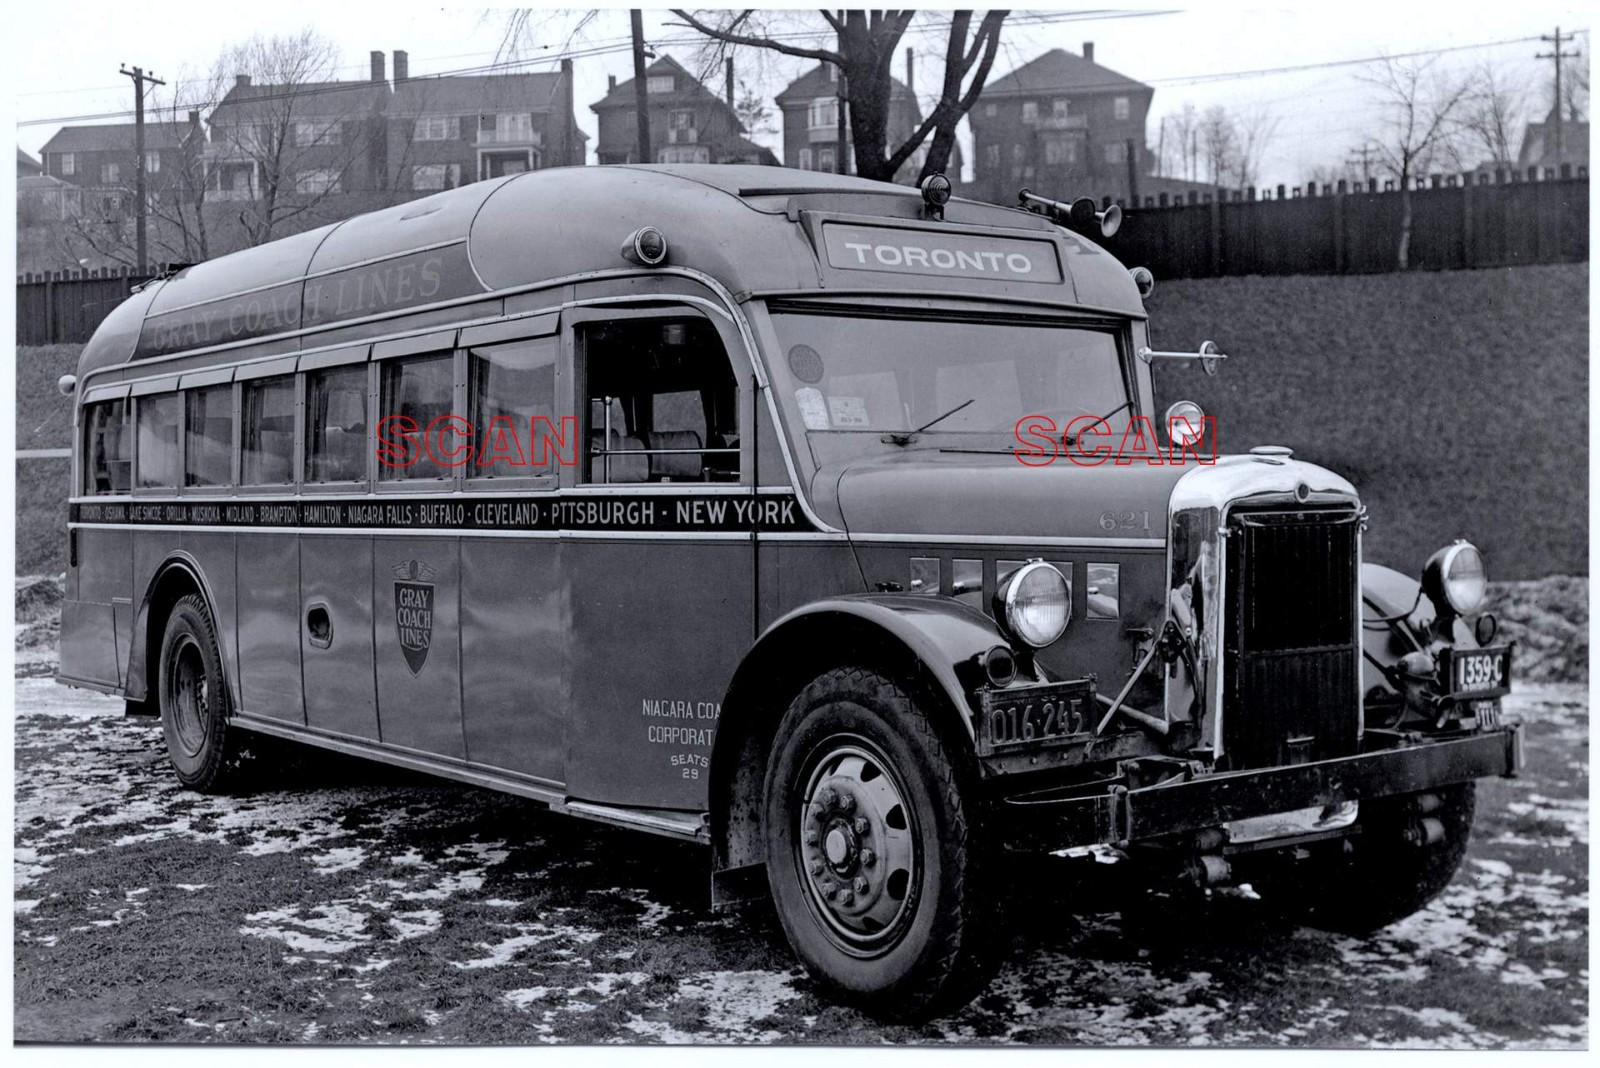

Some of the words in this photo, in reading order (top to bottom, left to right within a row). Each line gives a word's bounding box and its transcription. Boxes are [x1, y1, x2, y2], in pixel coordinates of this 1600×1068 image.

[845, 242, 1032, 273] TORONTO
[152, 309, 218, 350] GRAY
[228, 284, 322, 336] COACH
[335, 258, 443, 314] LINES
[192, 506, 221, 521] MUSKOKA
[226, 506, 254, 522] MIDLAND
[260, 506, 298, 523] BRAMPTON
[303, 505, 341, 524] HAMILTON
[348, 505, 384, 524] NIAGARA
[386, 505, 412, 525] FALLS
[420, 504, 465, 524] BUFFALO
[474, 503, 539, 525] CLEVELAND
[675, 501, 727, 524] NEW
[732, 500, 796, 524] YORK
[1099, 511, 1151, 531] 621
[400, 587, 429, 608] GRAY
[397, 607, 431, 629] COACH
[399, 627, 430, 651] LINES
[642, 698, 694, 719] NIAGARA
[670, 753, 709, 768] SEATS
[682, 767, 699, 780] 29
